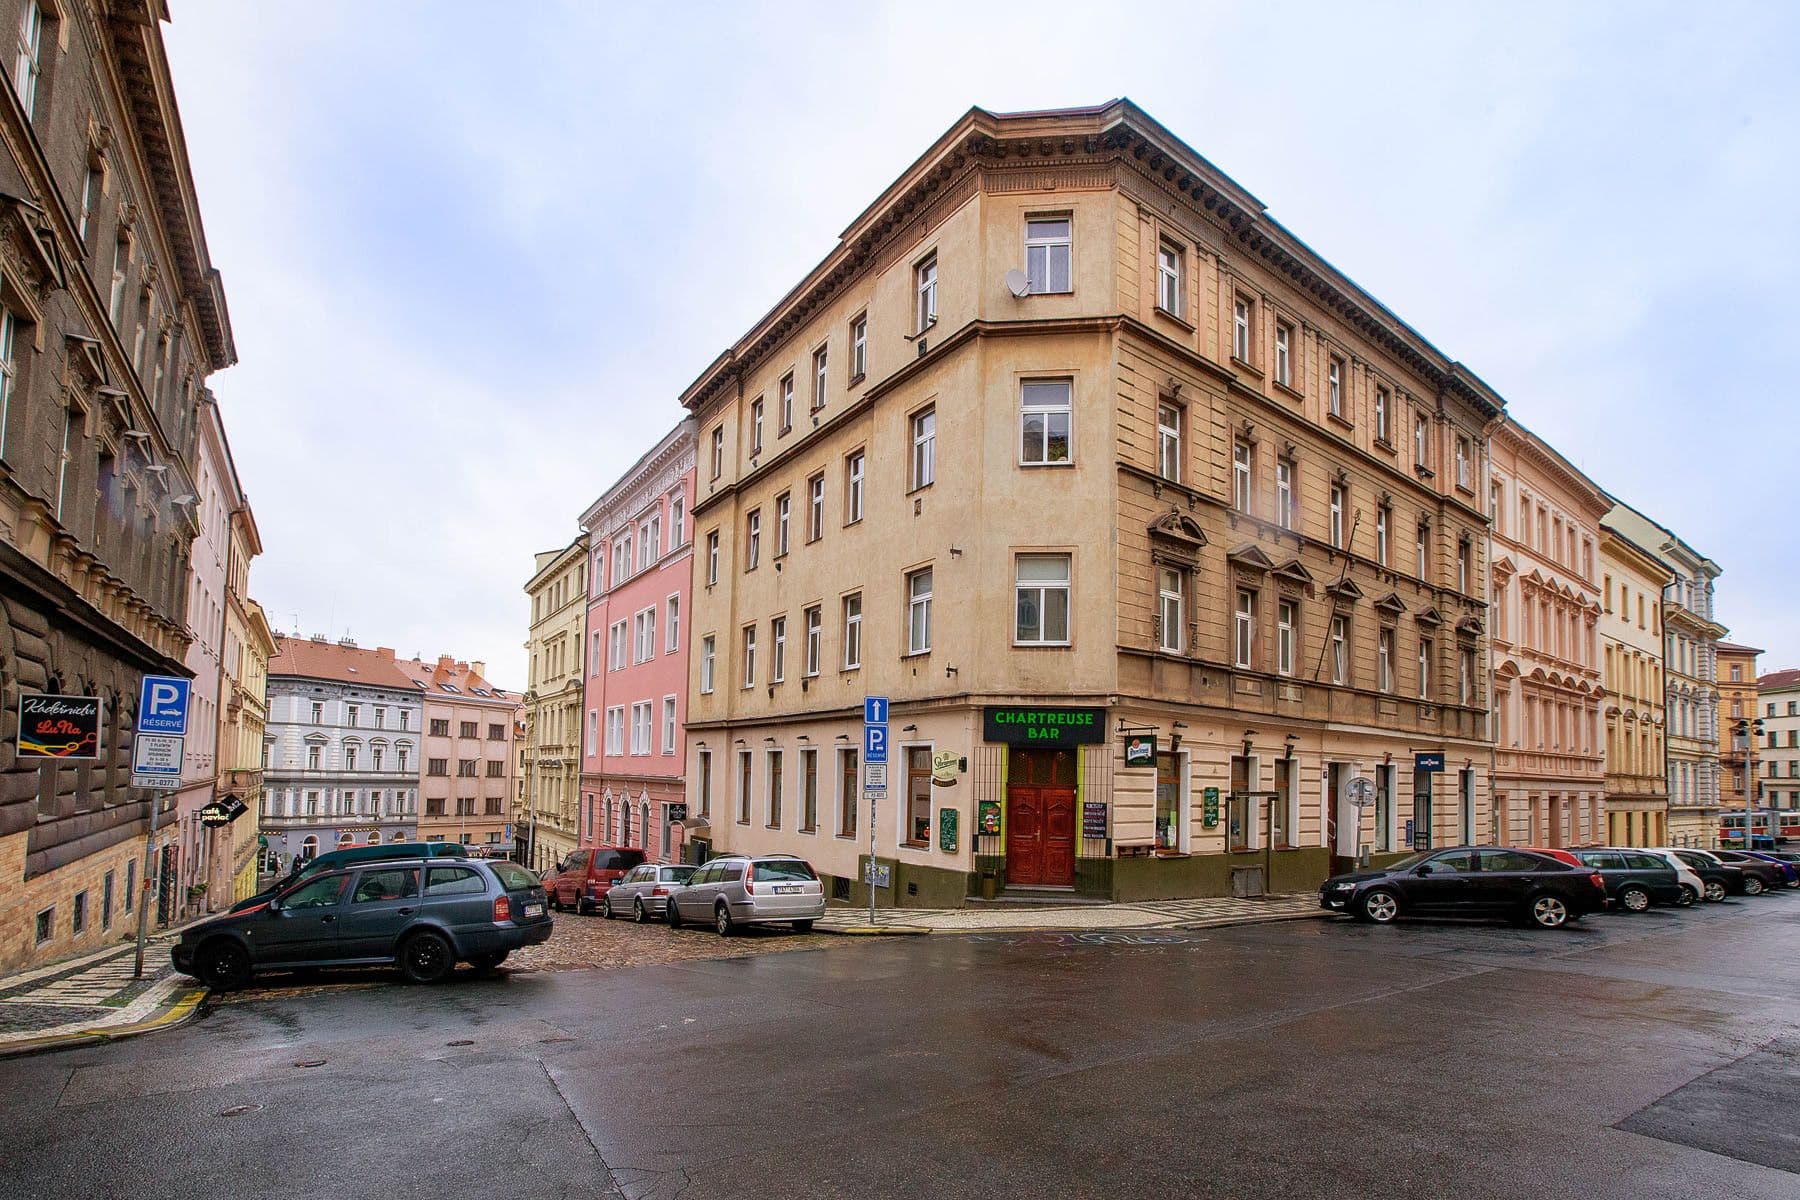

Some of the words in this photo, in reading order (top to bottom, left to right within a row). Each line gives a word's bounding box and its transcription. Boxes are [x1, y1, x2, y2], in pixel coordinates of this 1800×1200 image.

[150, 684, 179, 715] P
[995, 712, 1094, 725] CHARTREUSE
[870, 729, 883, 750] P
[1028, 727, 1060, 739] BAR
